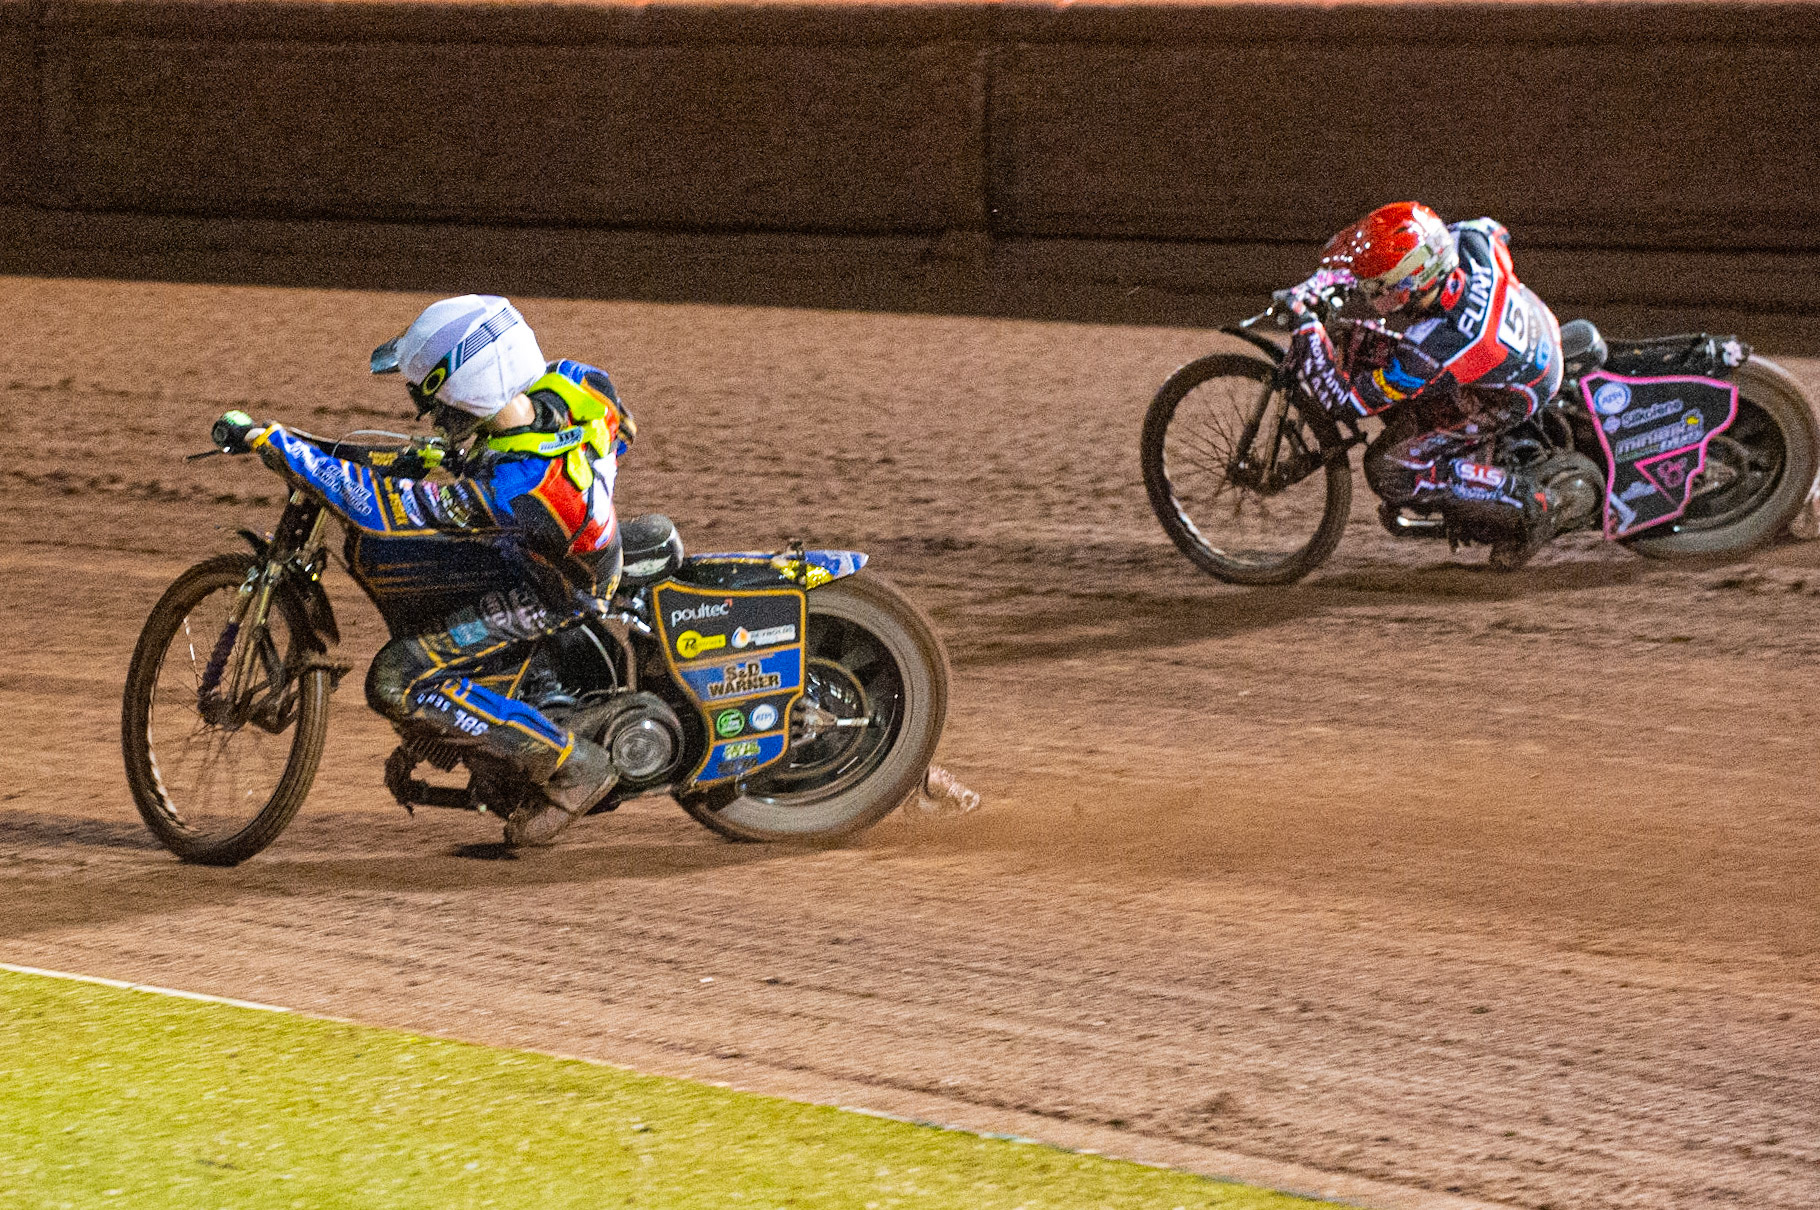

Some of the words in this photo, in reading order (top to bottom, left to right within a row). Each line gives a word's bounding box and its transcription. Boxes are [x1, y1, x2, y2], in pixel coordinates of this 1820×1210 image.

[1504, 298, 1525, 341] 5
[671, 601, 730, 627] poultec
[708, 674, 781, 698] WARNER
